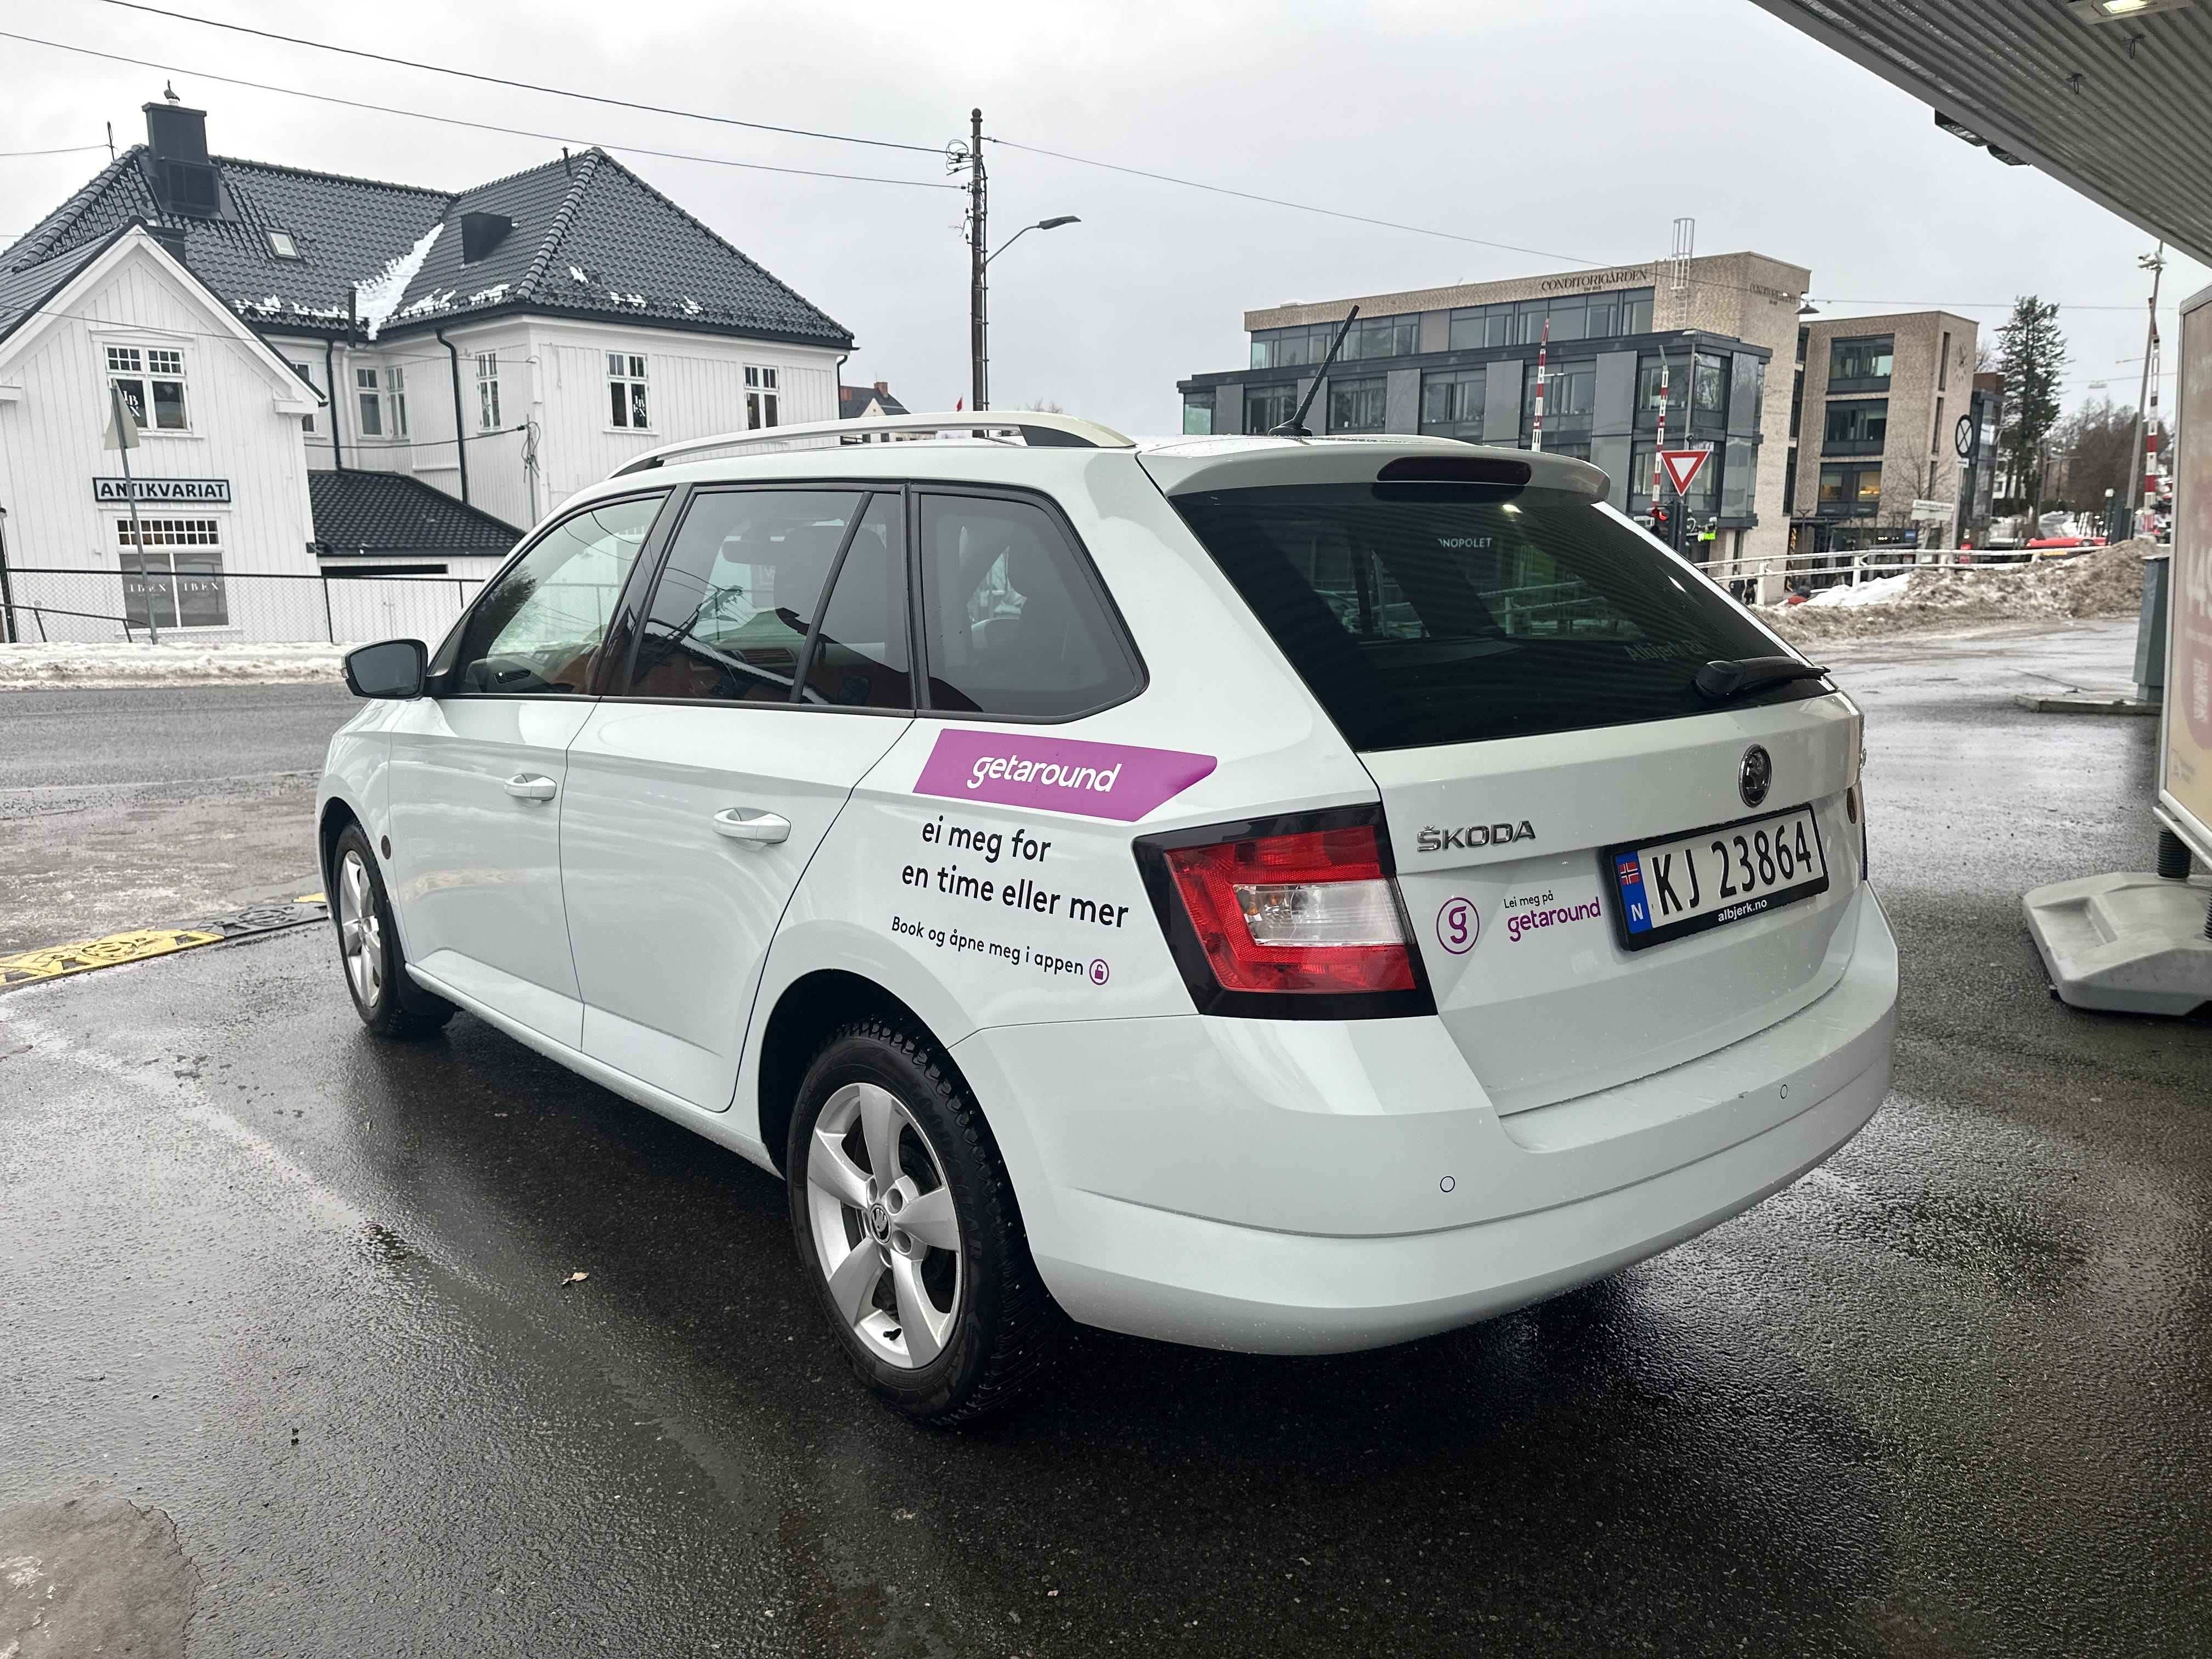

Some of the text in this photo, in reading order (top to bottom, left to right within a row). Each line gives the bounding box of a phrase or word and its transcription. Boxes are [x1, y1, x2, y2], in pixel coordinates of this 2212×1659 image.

[100, 482, 225, 498] ANTIKVARIAT
[967, 755, 1122, 792] getaround
[922, 815, 1051, 862] ei meg for
[1417, 820, 1536, 853] ŠKODA
[1651, 821, 1813, 916] KJ 23864
[902, 863, 1129, 928] en time eller mer
[1504, 890, 1554, 909] Lei meg på
[1630, 903, 1644, 922] N
[1718, 899, 1767, 922] albjerk.no
[1508, 896, 1601, 942] getaround
[891, 916, 1084, 975] Book og åpne meg i appen
